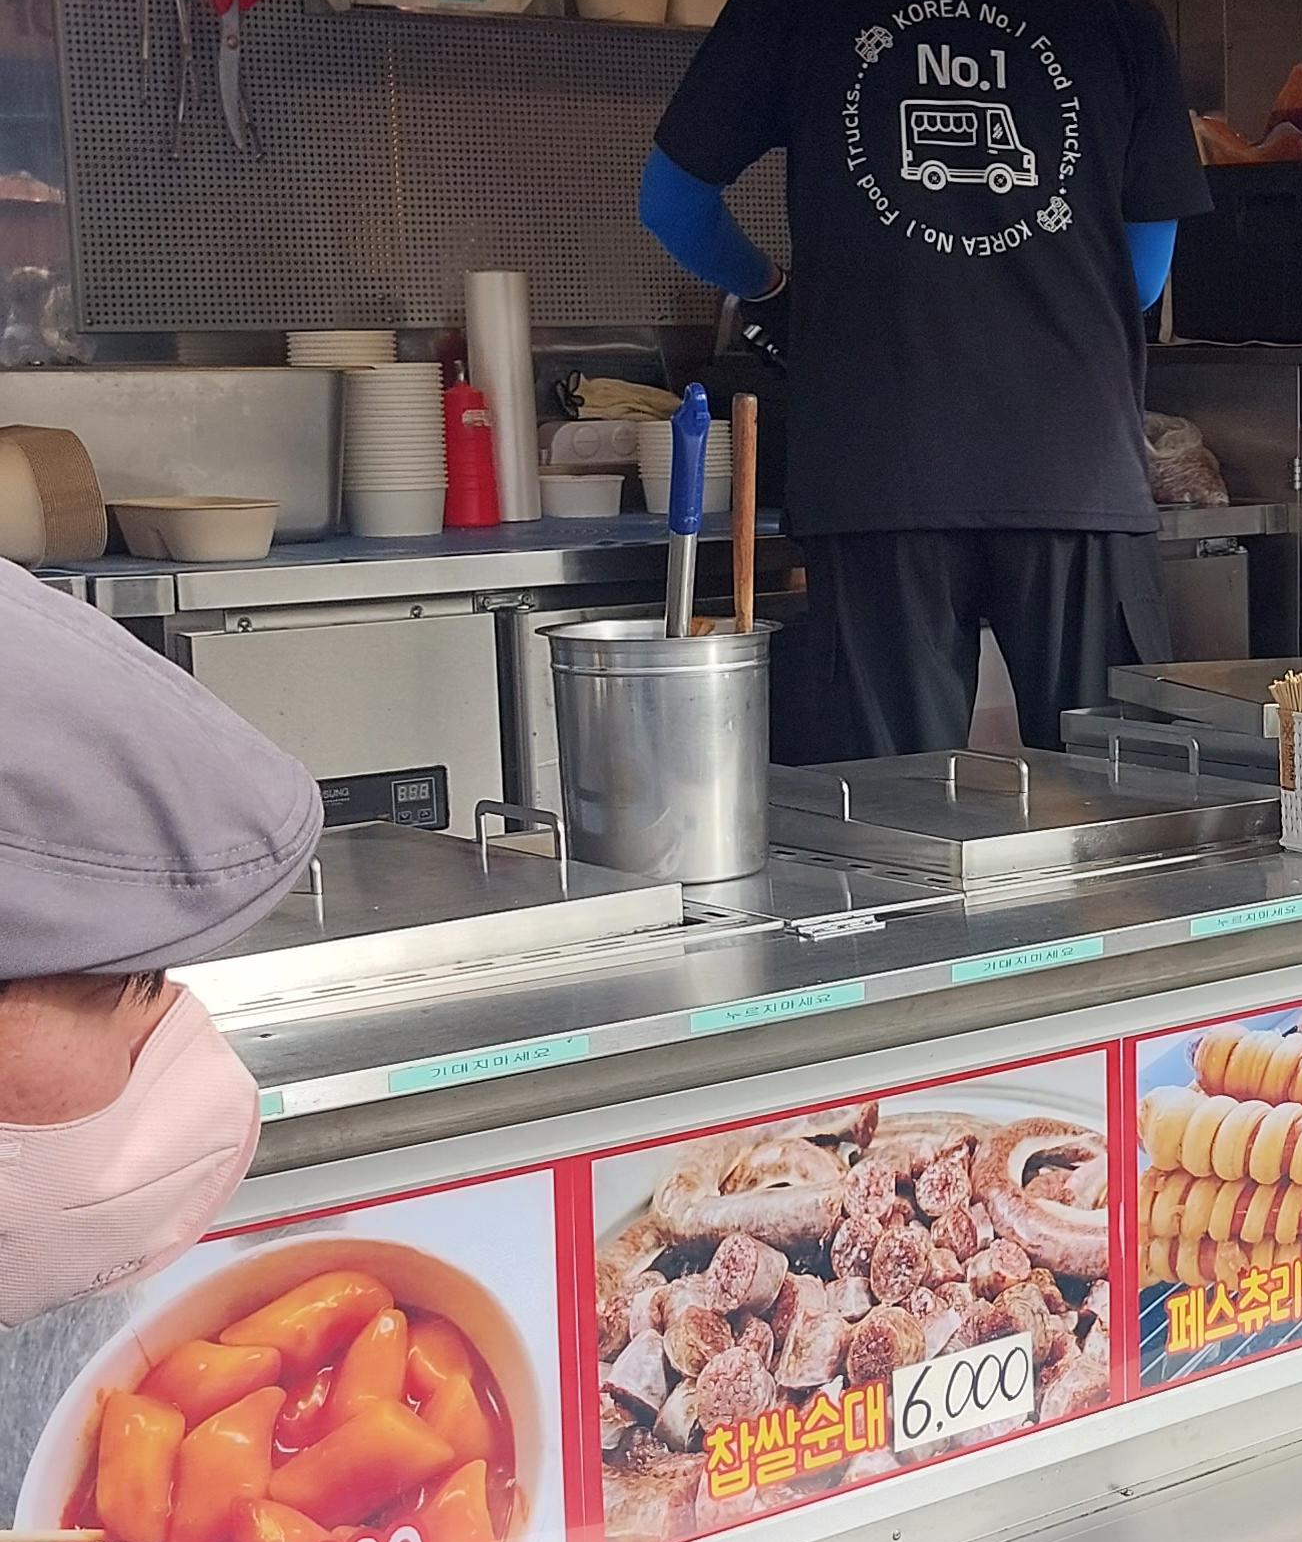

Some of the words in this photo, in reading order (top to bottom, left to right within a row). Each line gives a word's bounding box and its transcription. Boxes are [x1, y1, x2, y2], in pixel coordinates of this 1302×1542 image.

[892, 0, 971, 31] KOREA
[979, 3, 1028, 38] No.1
[1030, 35, 1074, 91] Food
[916, 43, 1008, 92] No.1
[856, 173, 901, 227] Food
[905, 219, 954, 254] No.1
[961, 219, 1034, 257] KOREA
[322, 787, 350, 800] SUNG
[983, 946, 1074, 972] 기대지마세요
[726, 993, 831, 1021] 누르지마세요
[430, 1048, 551, 1079] 기대지마세요
[901, 1346, 1030, 1440] 6,000
[706, 1383, 887, 1498] 찹쌀순대
